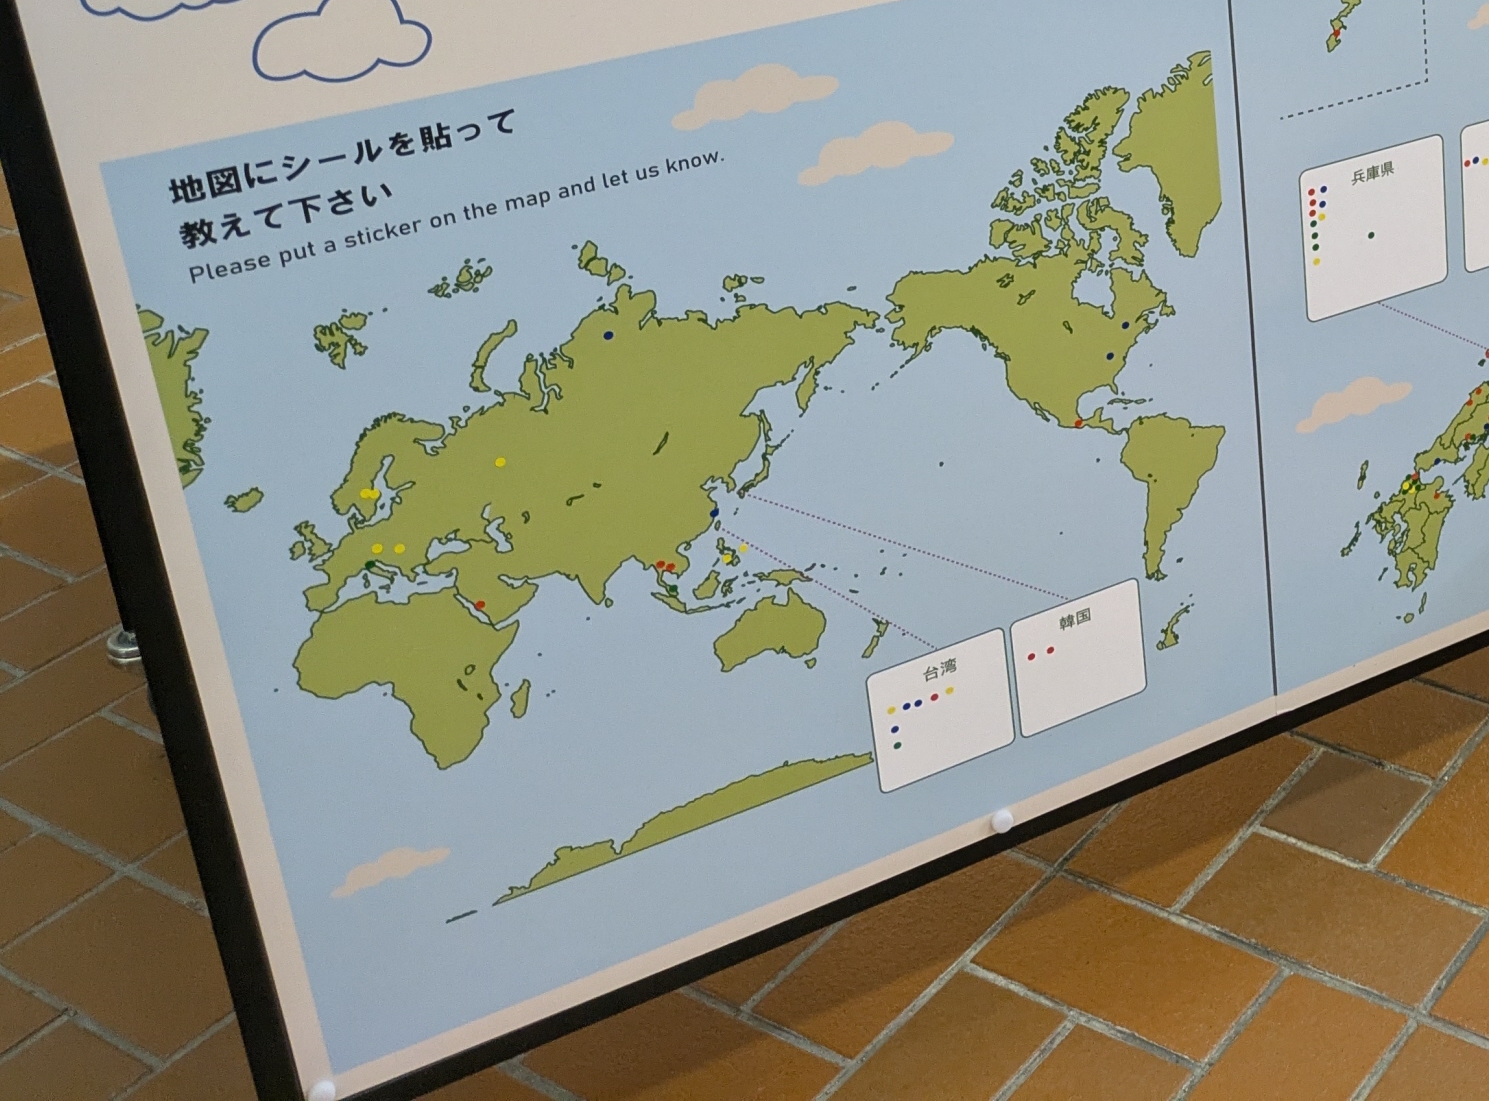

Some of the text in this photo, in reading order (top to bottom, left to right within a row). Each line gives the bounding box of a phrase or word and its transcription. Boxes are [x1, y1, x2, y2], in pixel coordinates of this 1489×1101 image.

[168, 107, 516, 206] 地図にシールを貼って
[1351, 160, 1395, 186] 兵庫県
[179, 180, 393, 251] 教えて下さい
[188, 149, 726, 285] Please put a sticker on the map and let us know.
[1059, 607, 1092, 631] 韓国
[922, 657, 958, 683] 台湾
